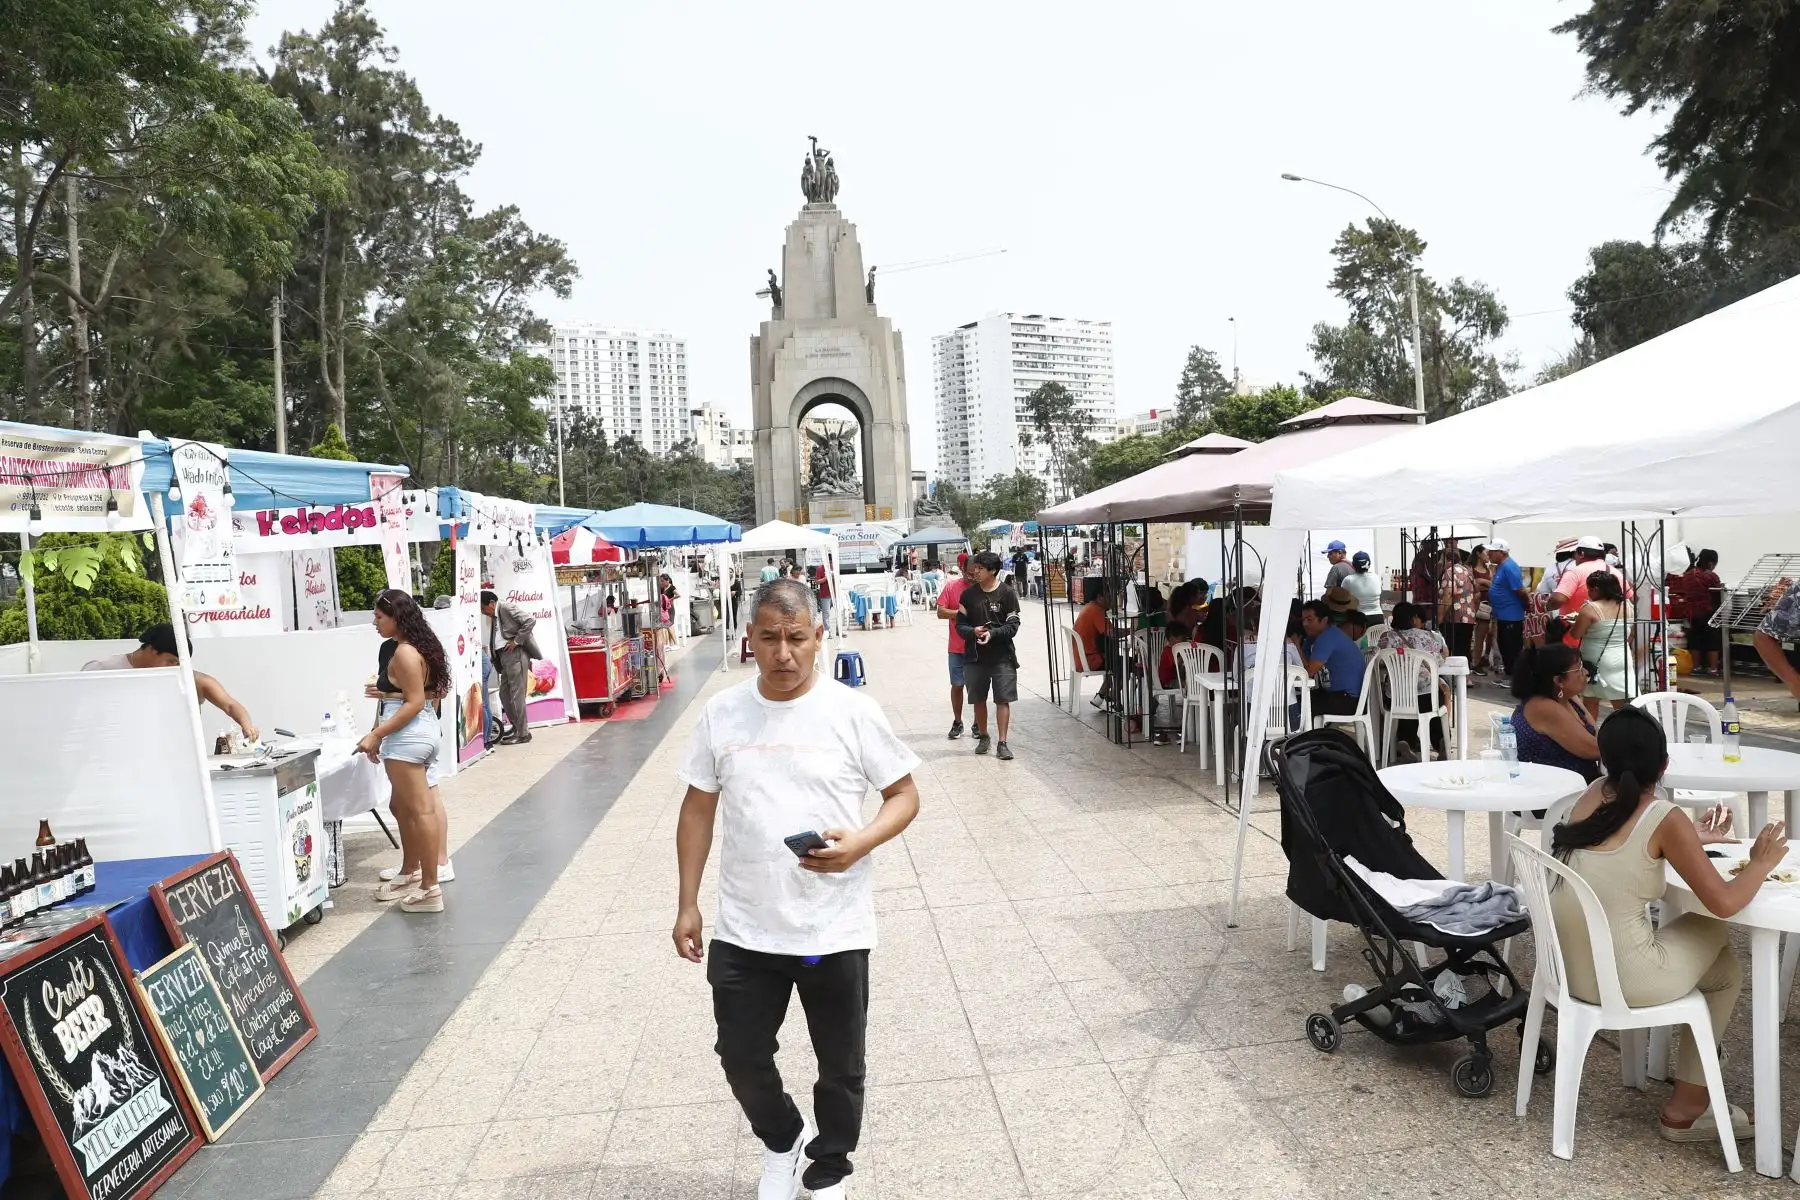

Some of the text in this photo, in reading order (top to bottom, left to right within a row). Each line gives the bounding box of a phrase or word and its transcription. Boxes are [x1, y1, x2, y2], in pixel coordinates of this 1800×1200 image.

[256, 504, 377, 537] Helados
[857, 531, 880, 541] Sour
[166, 864, 241, 926] CERVEZA
[207, 936, 242, 967] Quinua
[240, 944, 270, 975] Trigo
[42, 957, 95, 1020] Craft
[147, 955, 209, 1016] CERVEZA
[231, 970, 278, 1018] Almendras
[52, 994, 112, 1063] BEER
[92, 1118, 183, 1200] CERVECERIA ARTESANAL
